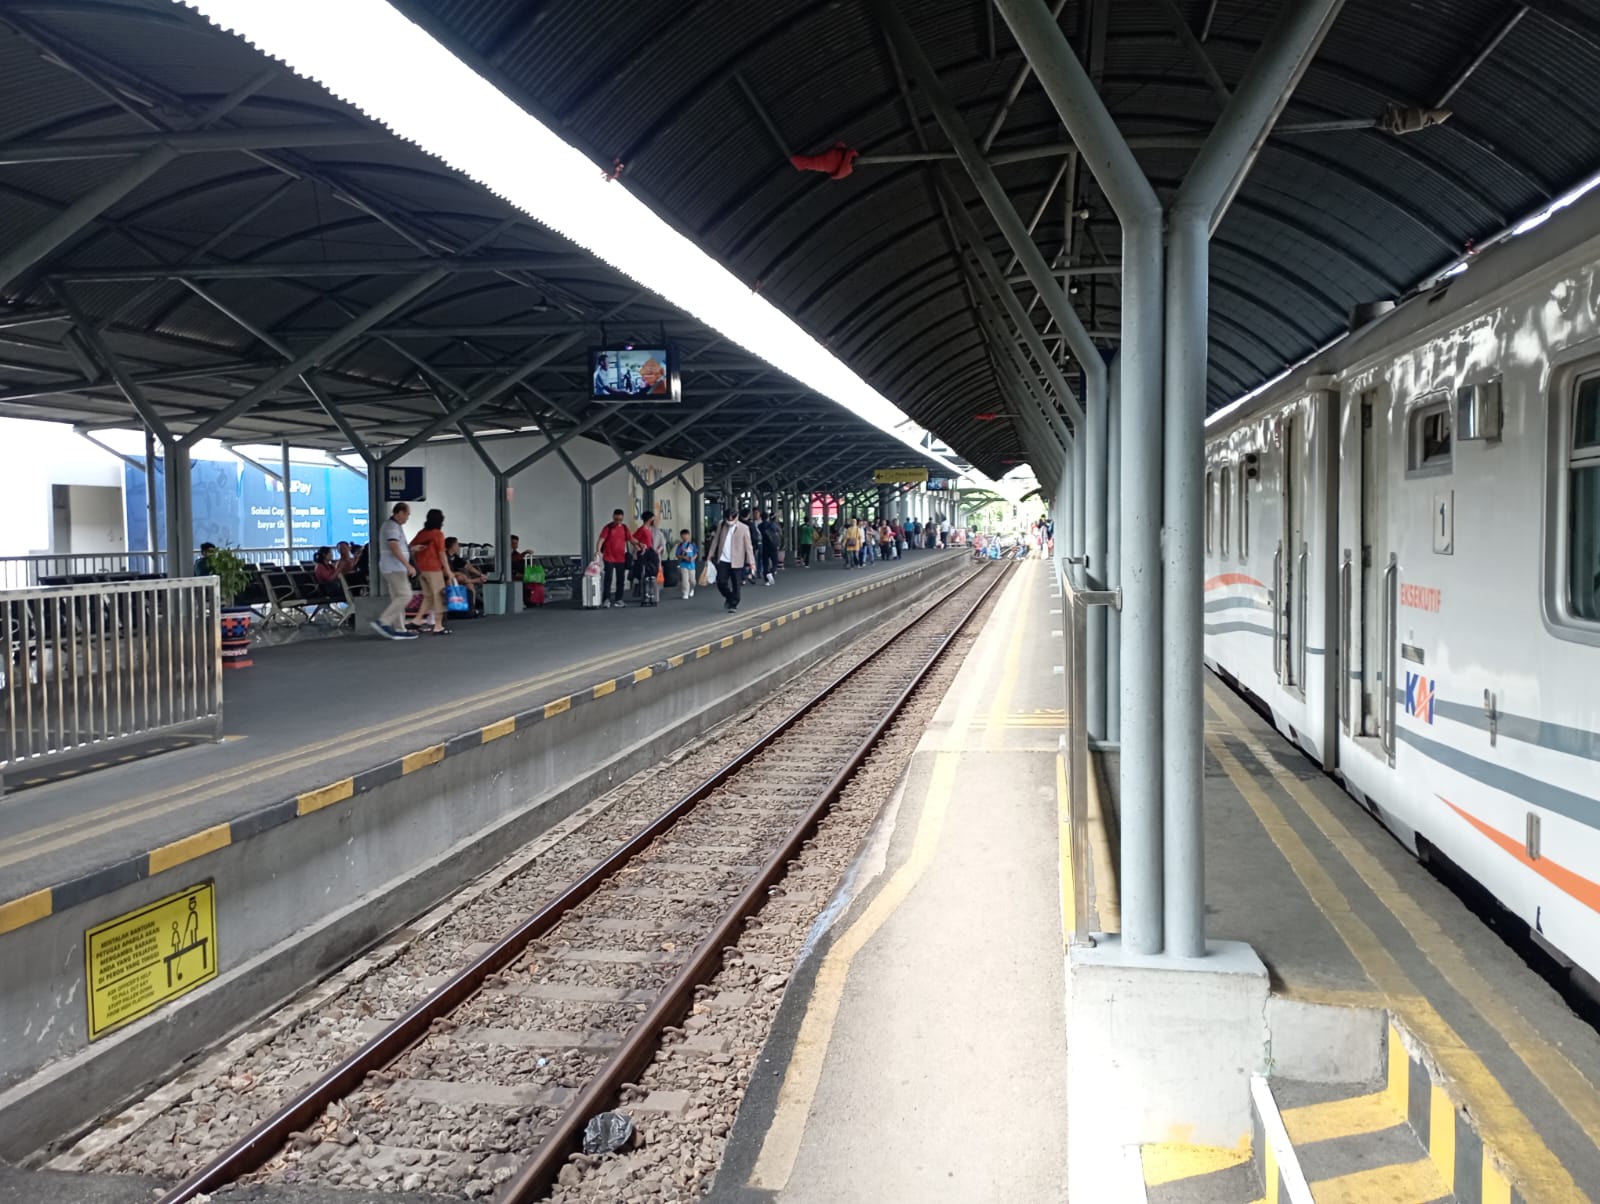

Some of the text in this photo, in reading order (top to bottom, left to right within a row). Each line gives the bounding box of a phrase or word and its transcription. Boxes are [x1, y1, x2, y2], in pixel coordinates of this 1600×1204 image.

[1400, 583, 1441, 613] EKSEKUTIF
[1405, 671, 1435, 725] KAI
[100, 963, 114, 974] ANDA
[117, 956, 131, 966] YANG
[126, 960, 139, 971] YANG
